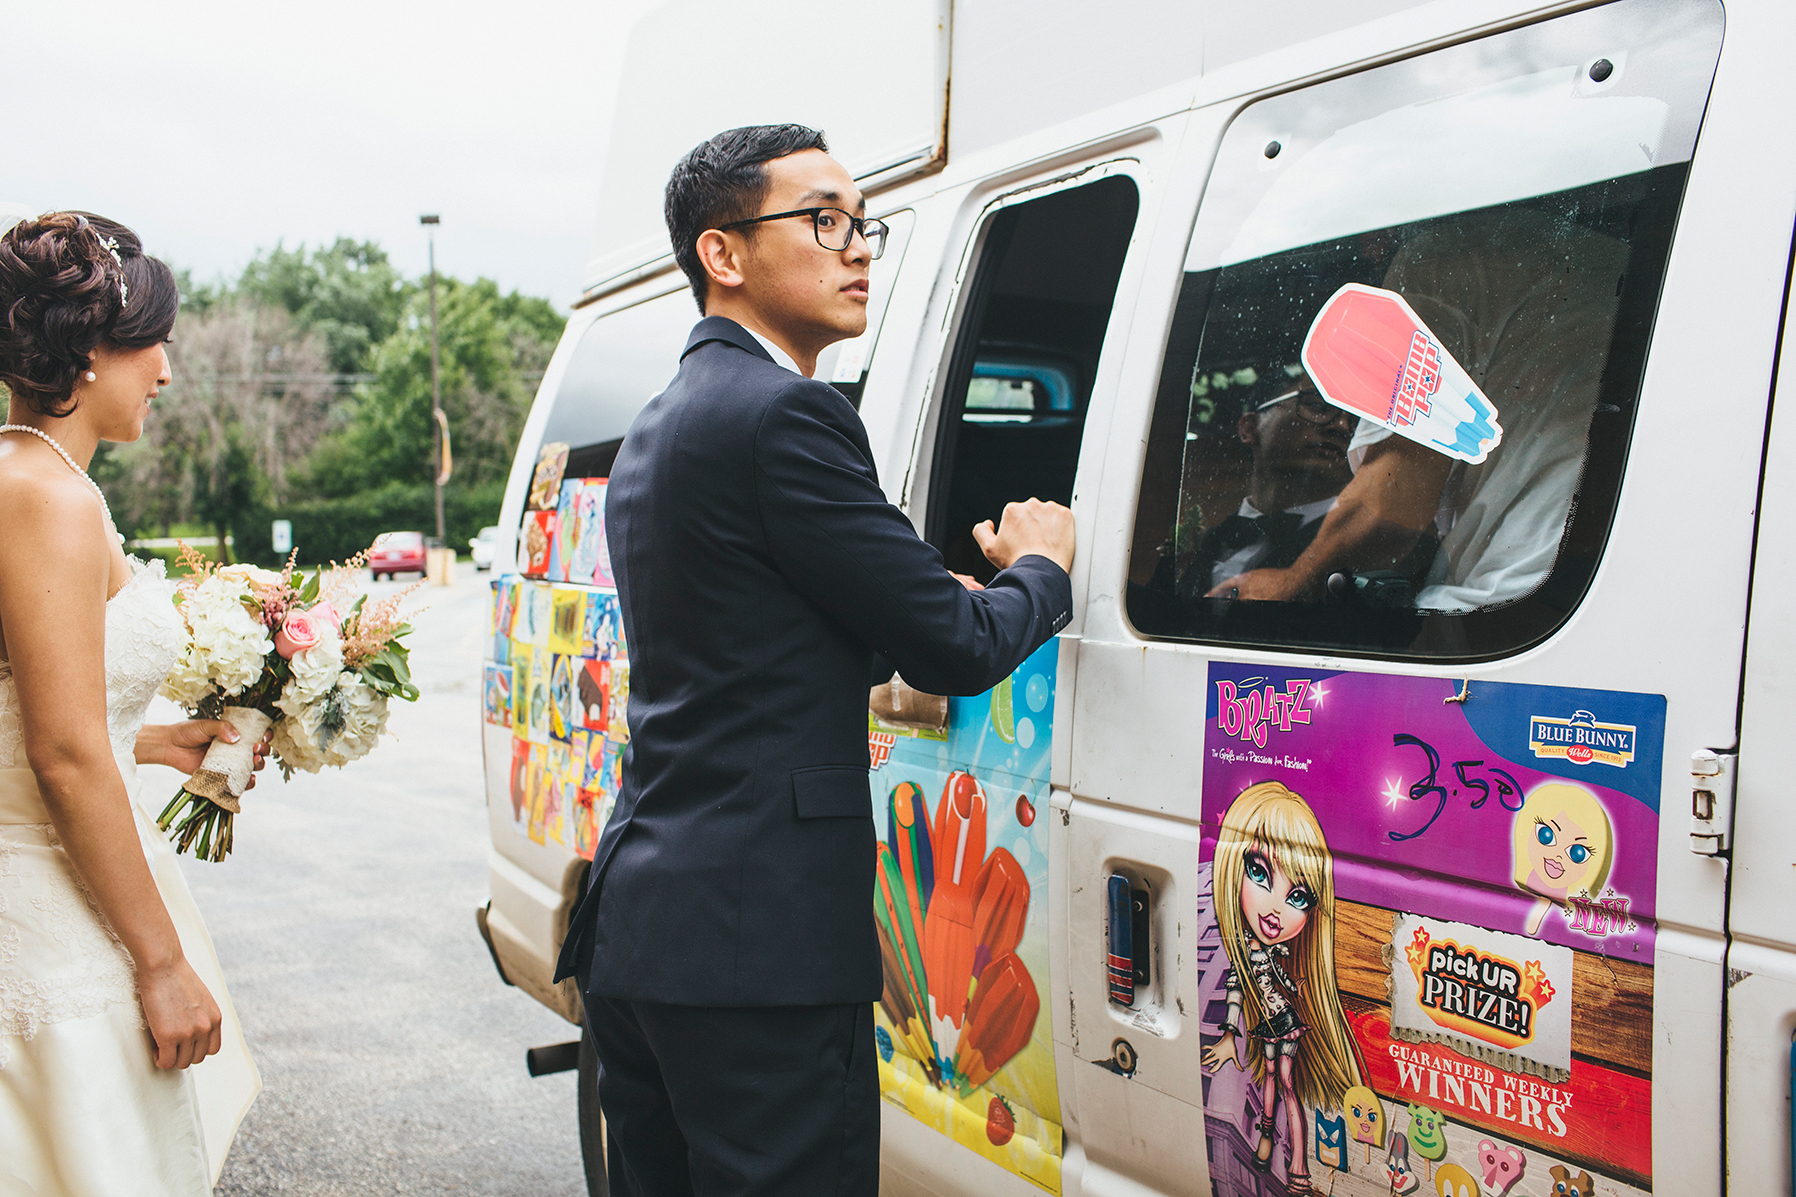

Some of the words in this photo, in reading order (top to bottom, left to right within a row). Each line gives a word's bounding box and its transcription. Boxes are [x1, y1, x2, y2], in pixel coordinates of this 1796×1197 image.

[1391, 332, 1428, 423] BOMB
[1410, 345, 1440, 422] POP
[1214, 679, 1312, 749] BRATZ
[1537, 724, 1573, 743] BLUE
[1247, 750, 1273, 765] Passion
[1567, 747, 1592, 758] Wells
[1594, 752, 1610, 760] SINCE
[1388, 733, 1525, 842] 3.50
[1567, 896, 1630, 937] NEW
[1431, 948, 1480, 982] pick
[1481, 962, 1518, 994] UR
[1423, 973, 1530, 1035] PRIZE!
[1388, 1044, 1495, 1084] GUARANTEED
[1503, 1074, 1574, 1108] WEEKLY
[1394, 1059, 1568, 1138] WINNERS
